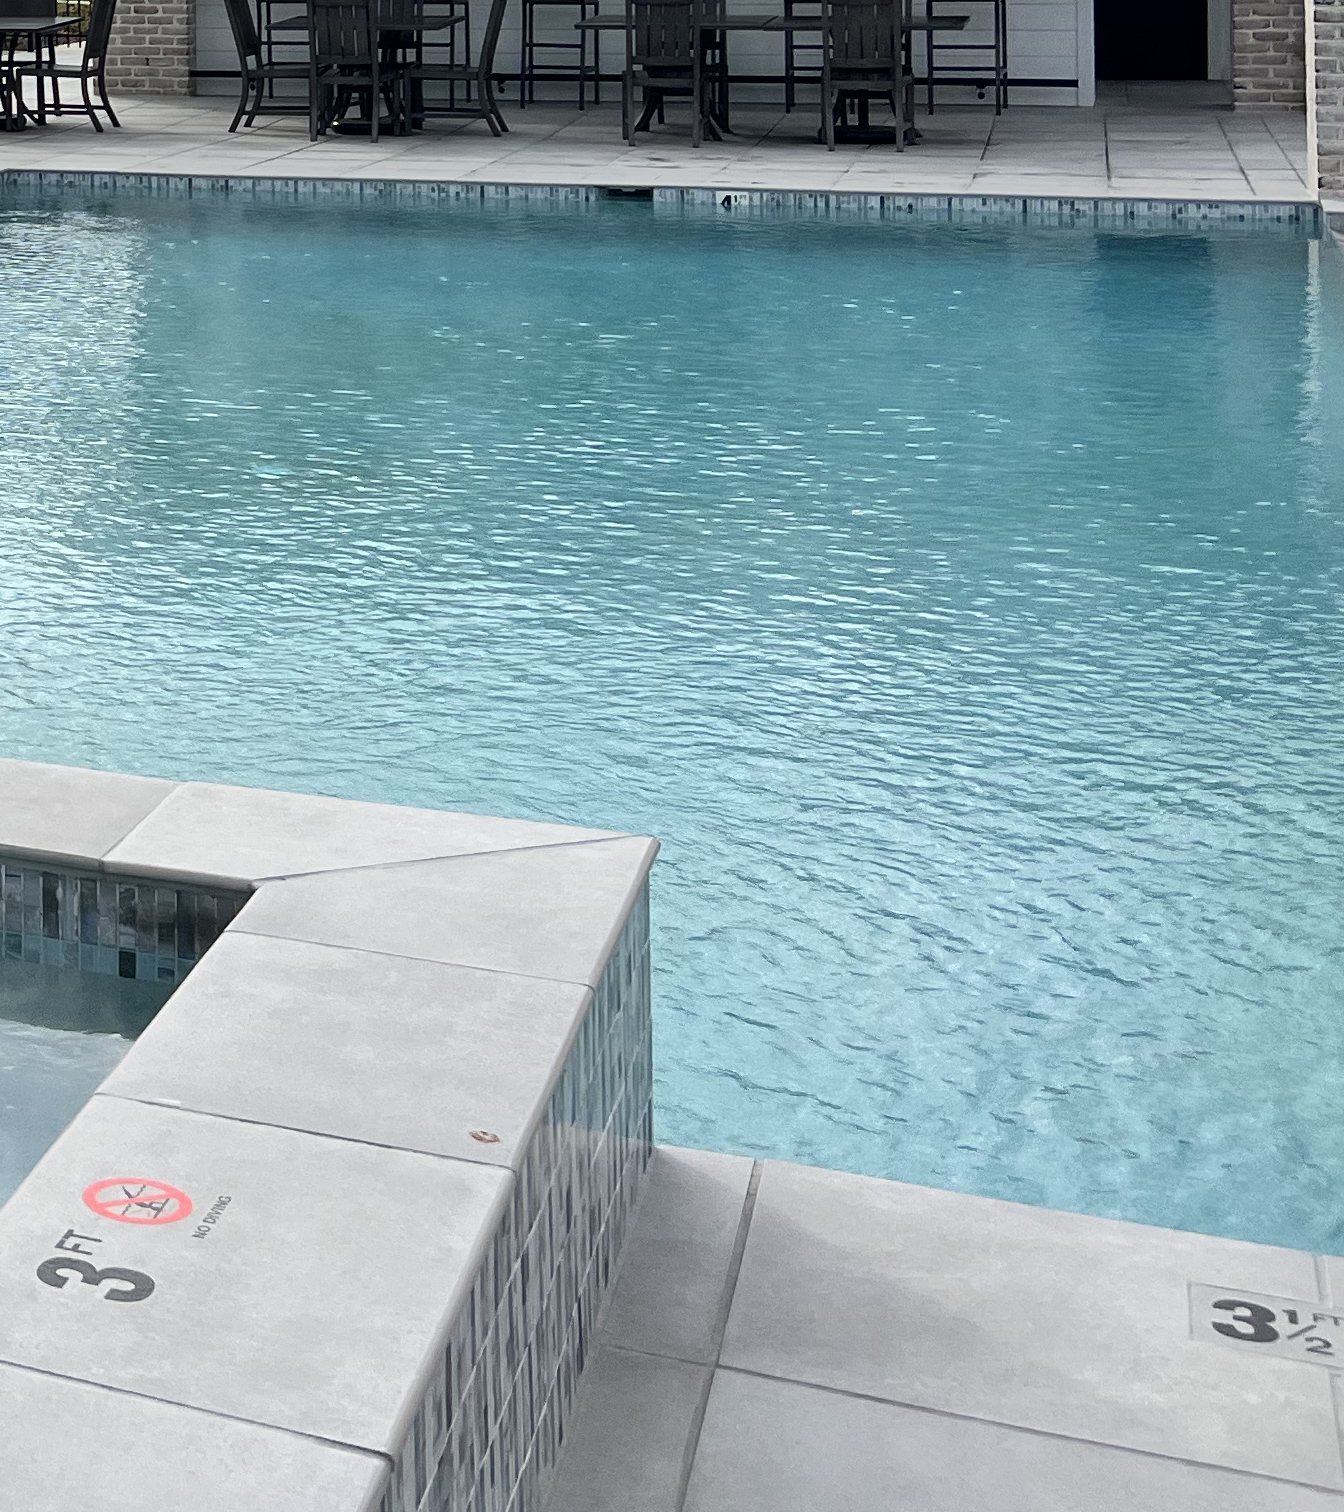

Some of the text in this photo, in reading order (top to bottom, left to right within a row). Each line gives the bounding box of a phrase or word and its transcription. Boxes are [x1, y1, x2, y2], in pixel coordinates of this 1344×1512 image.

[192, 1194, 232, 1240] NO DIVING
[36, 1228, 156, 1303] 3 FT
[1211, 1298, 1280, 1343] 3
